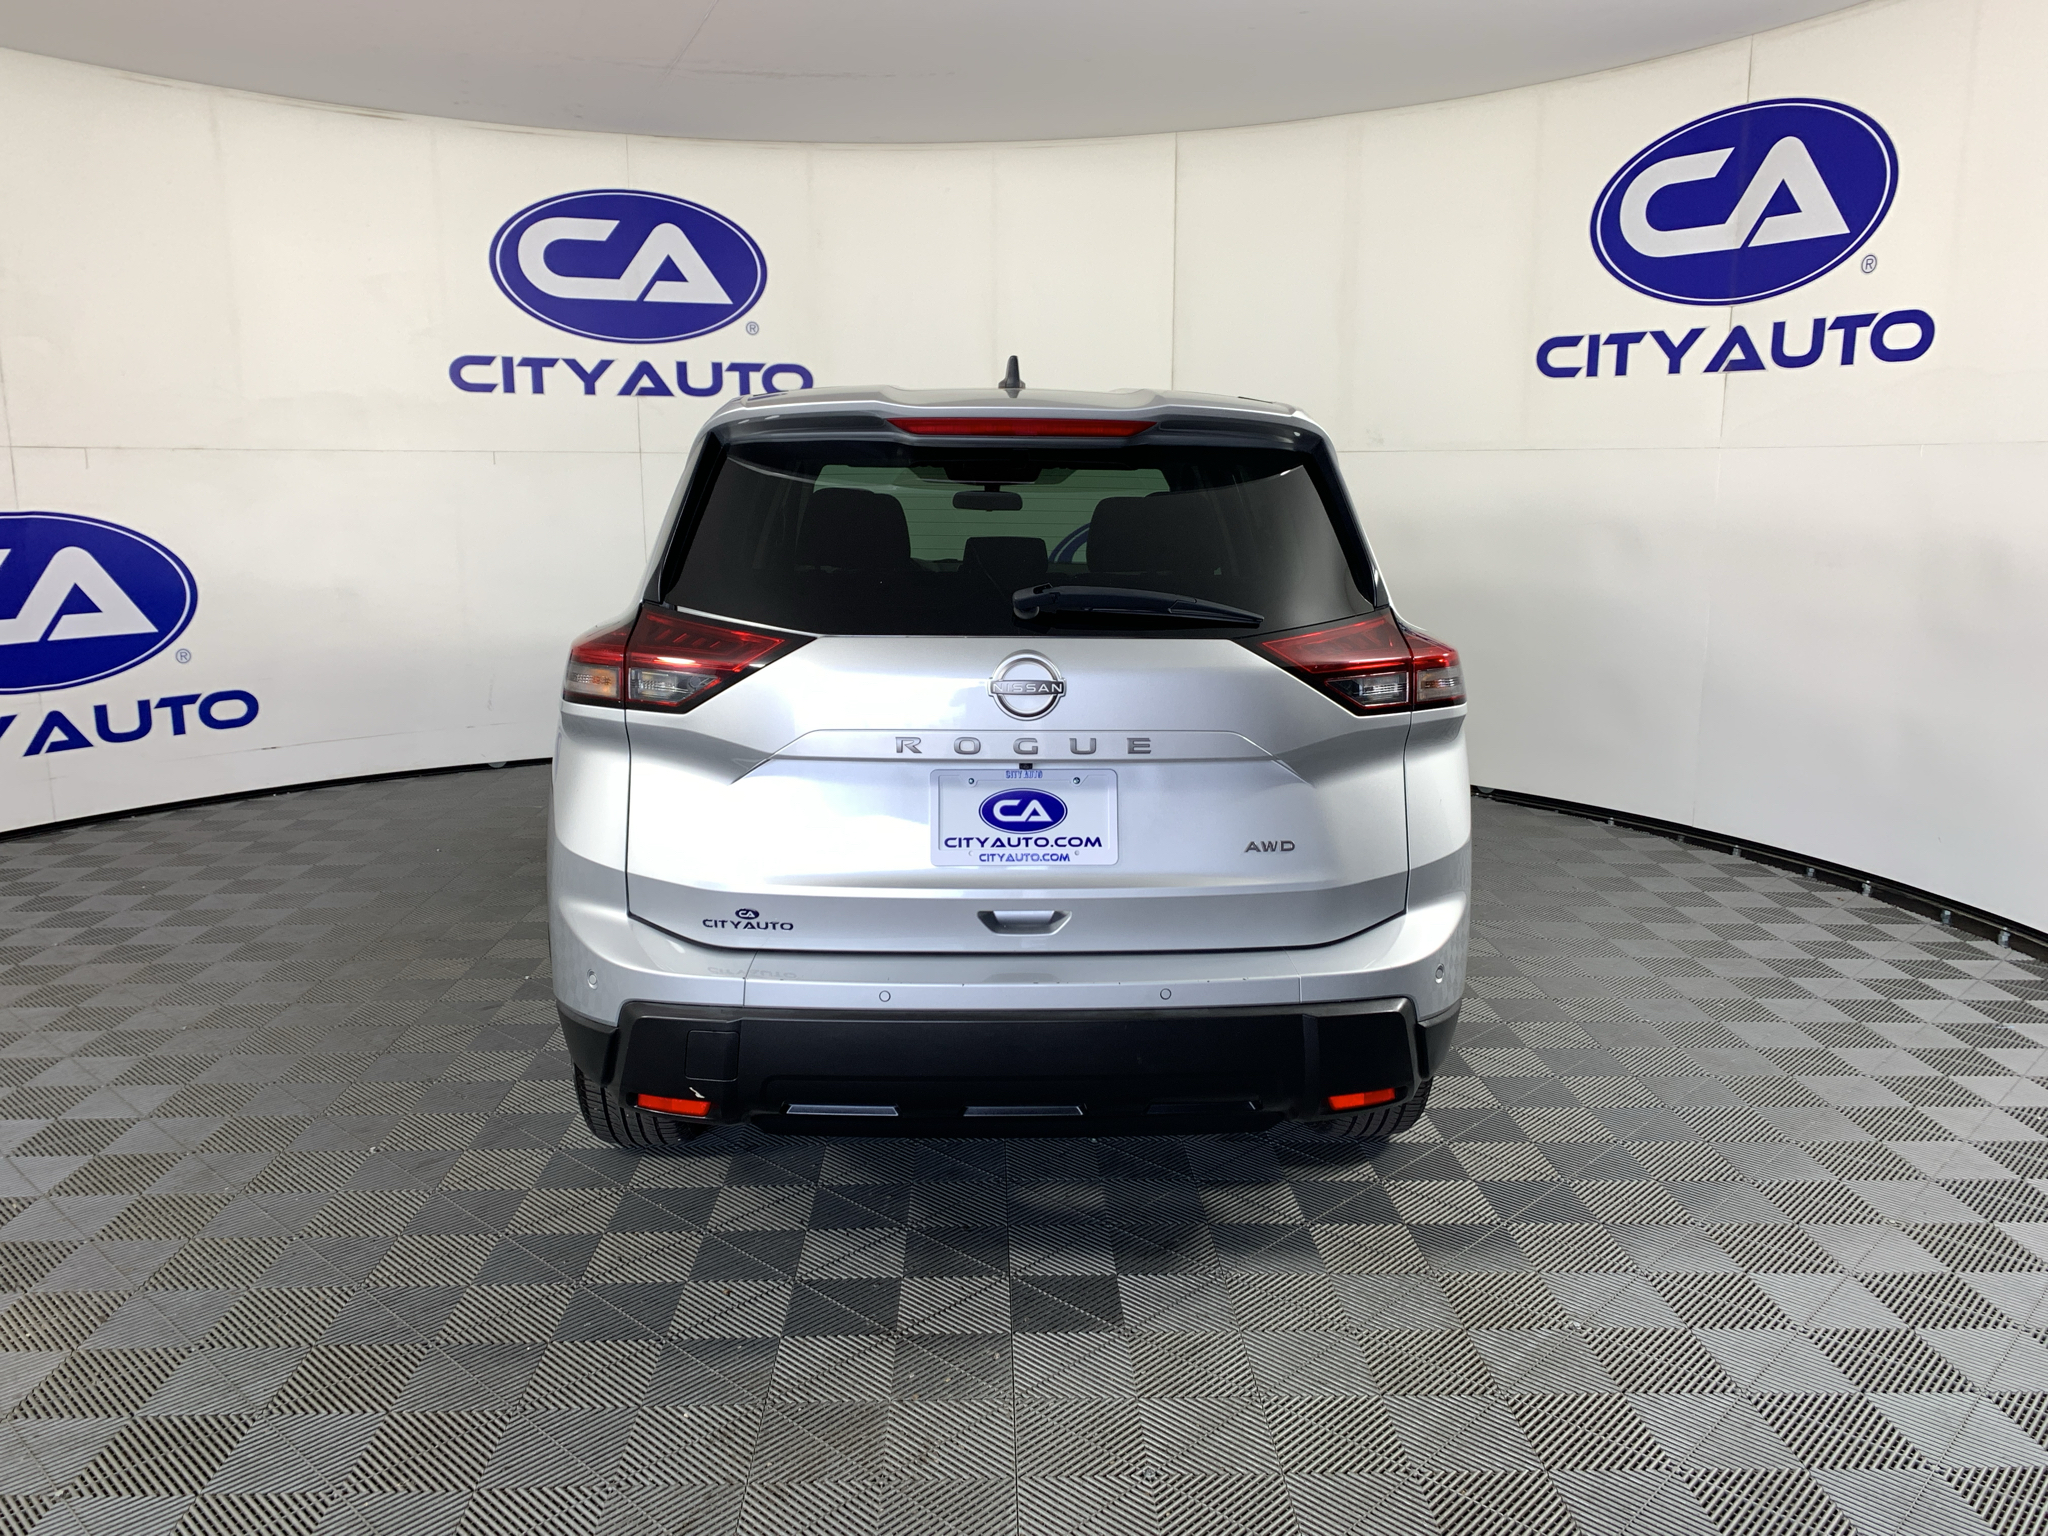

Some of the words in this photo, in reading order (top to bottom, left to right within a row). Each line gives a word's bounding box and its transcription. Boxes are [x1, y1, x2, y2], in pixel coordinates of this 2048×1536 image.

[1619, 135, 1851, 258] CA
[517, 216, 734, 305] CA
[0, 546, 159, 646] A
[992, 683, 1063, 693] NISSAN
[895, 736, 1152, 755] ROGUE
[1005, 770, 1022, 779] CITY
[1023, 770, 1043, 779] AUTO
[992, 799, 1054, 822] CA
[944, 836, 1103, 849] CITYAUTO.COM
[1244, 840, 1296, 853] AWD
[978, 852, 1071, 863] CITYAUTO.COM
